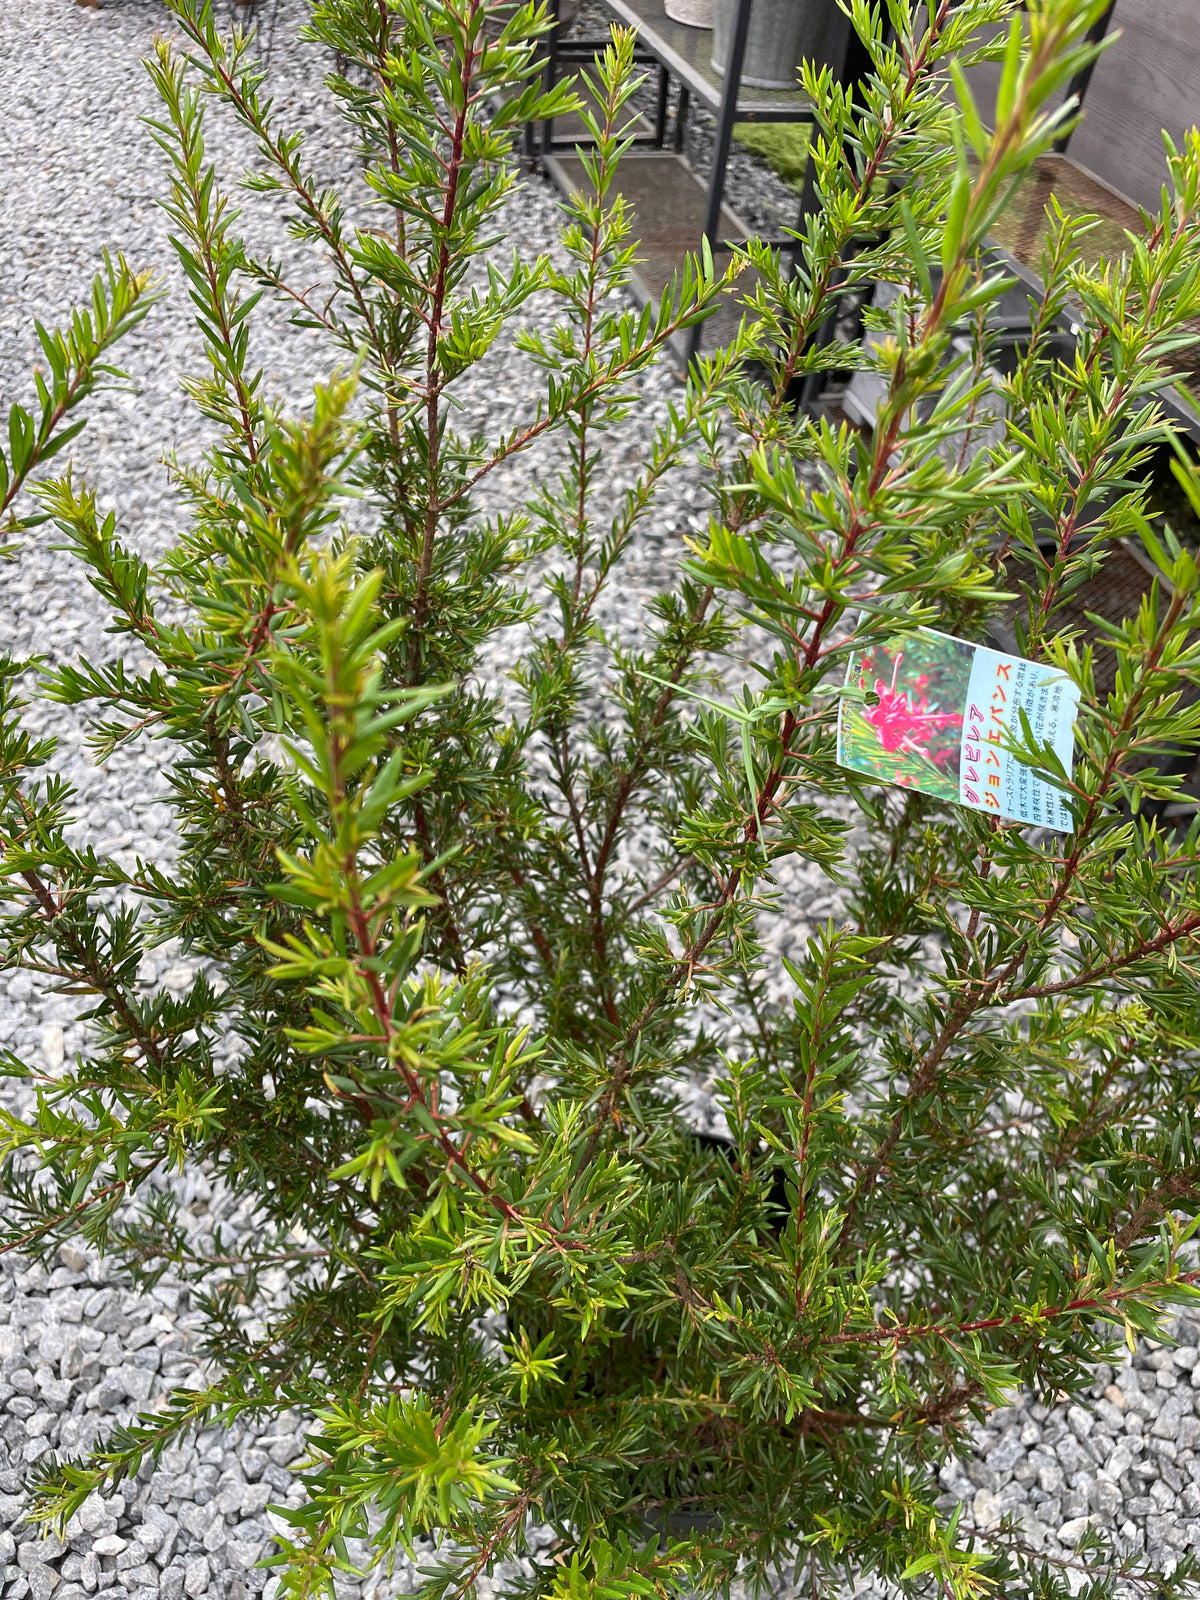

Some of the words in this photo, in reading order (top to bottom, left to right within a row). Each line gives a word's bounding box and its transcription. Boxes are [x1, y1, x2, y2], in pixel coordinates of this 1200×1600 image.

[962, 703, 985, 804] グレビレア
[984, 664, 1012, 809] ジョンエバンス
